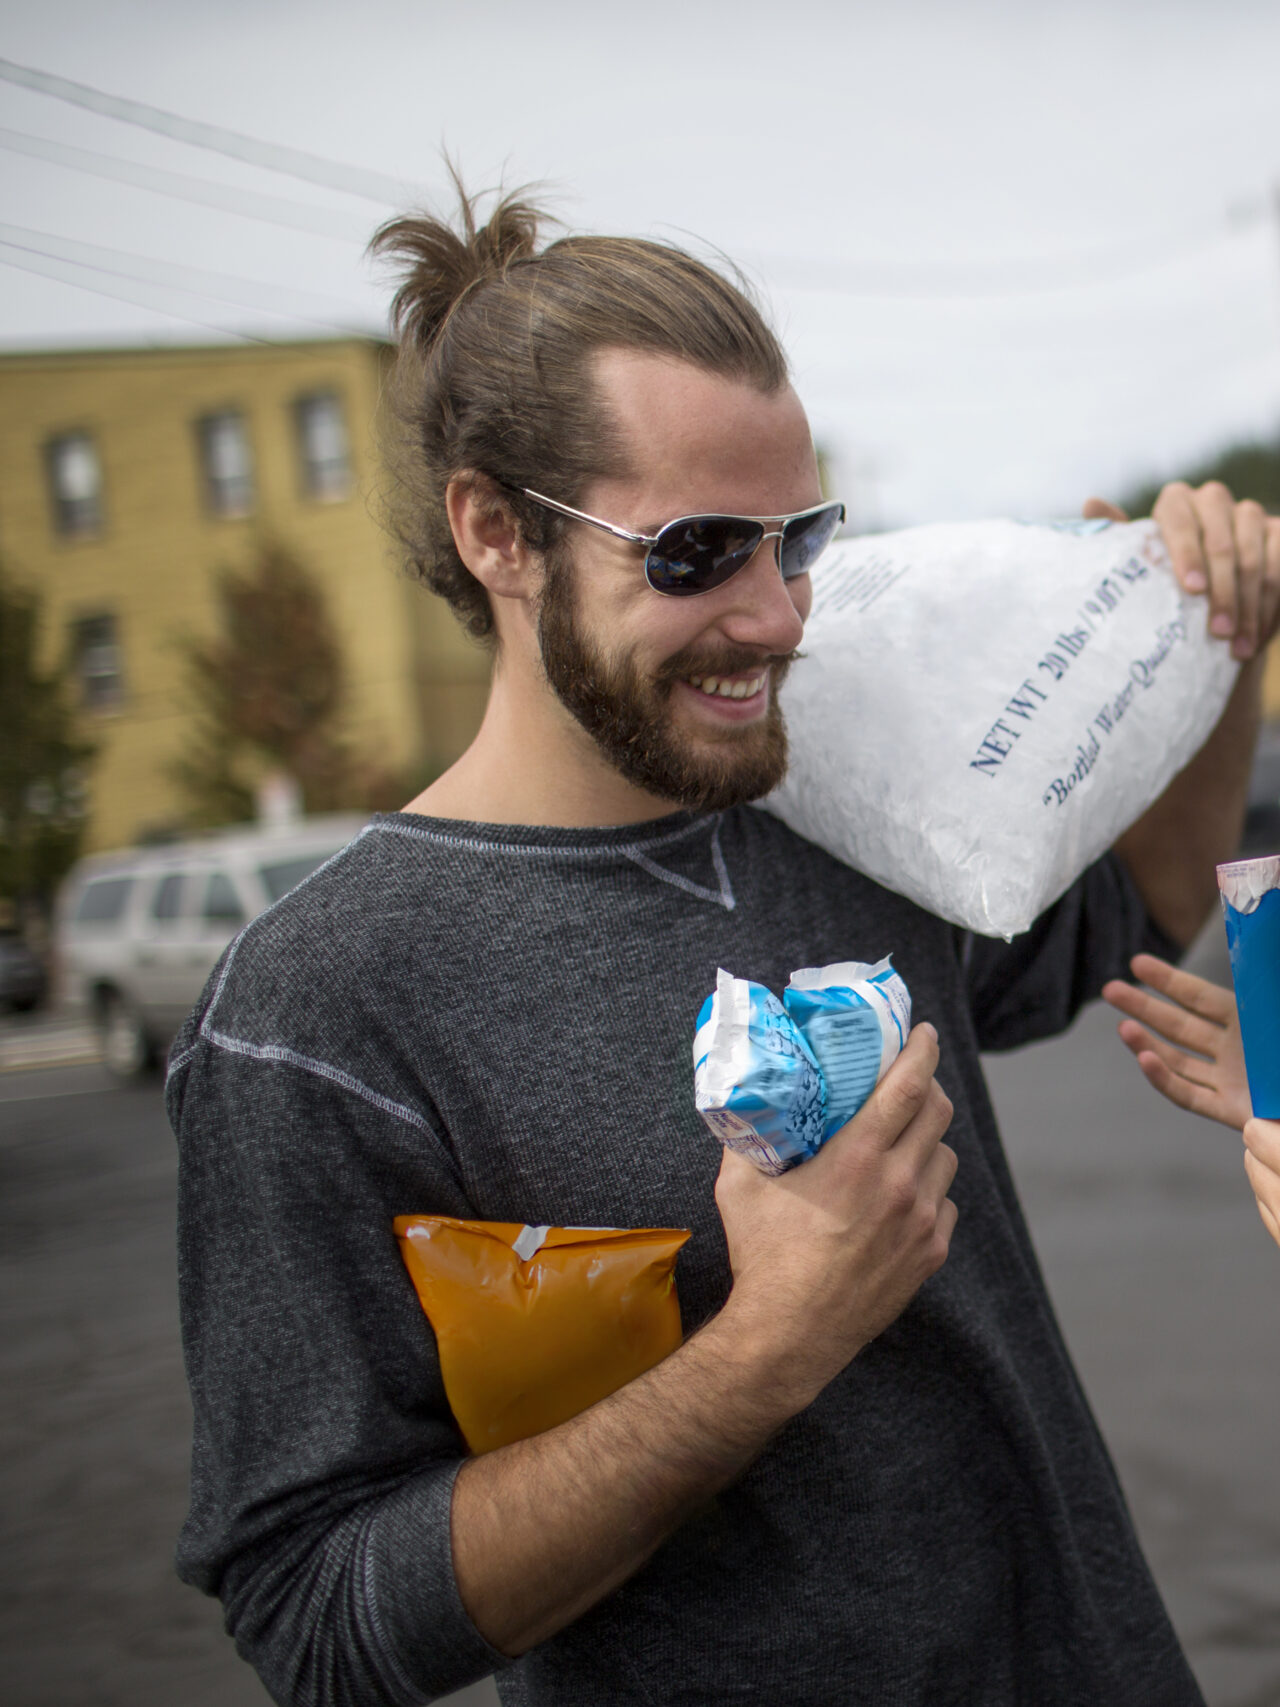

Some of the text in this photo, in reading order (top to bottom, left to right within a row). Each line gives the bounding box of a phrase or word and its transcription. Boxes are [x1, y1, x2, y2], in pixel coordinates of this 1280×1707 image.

[969, 718, 1021, 777] NET
[1005, 677, 1047, 720] WT
[1038, 652, 1069, 681] 20
[1054, 626, 1090, 658] lbs
[1111, 556, 1148, 584] kg
[1094, 681, 1133, 735] Water
